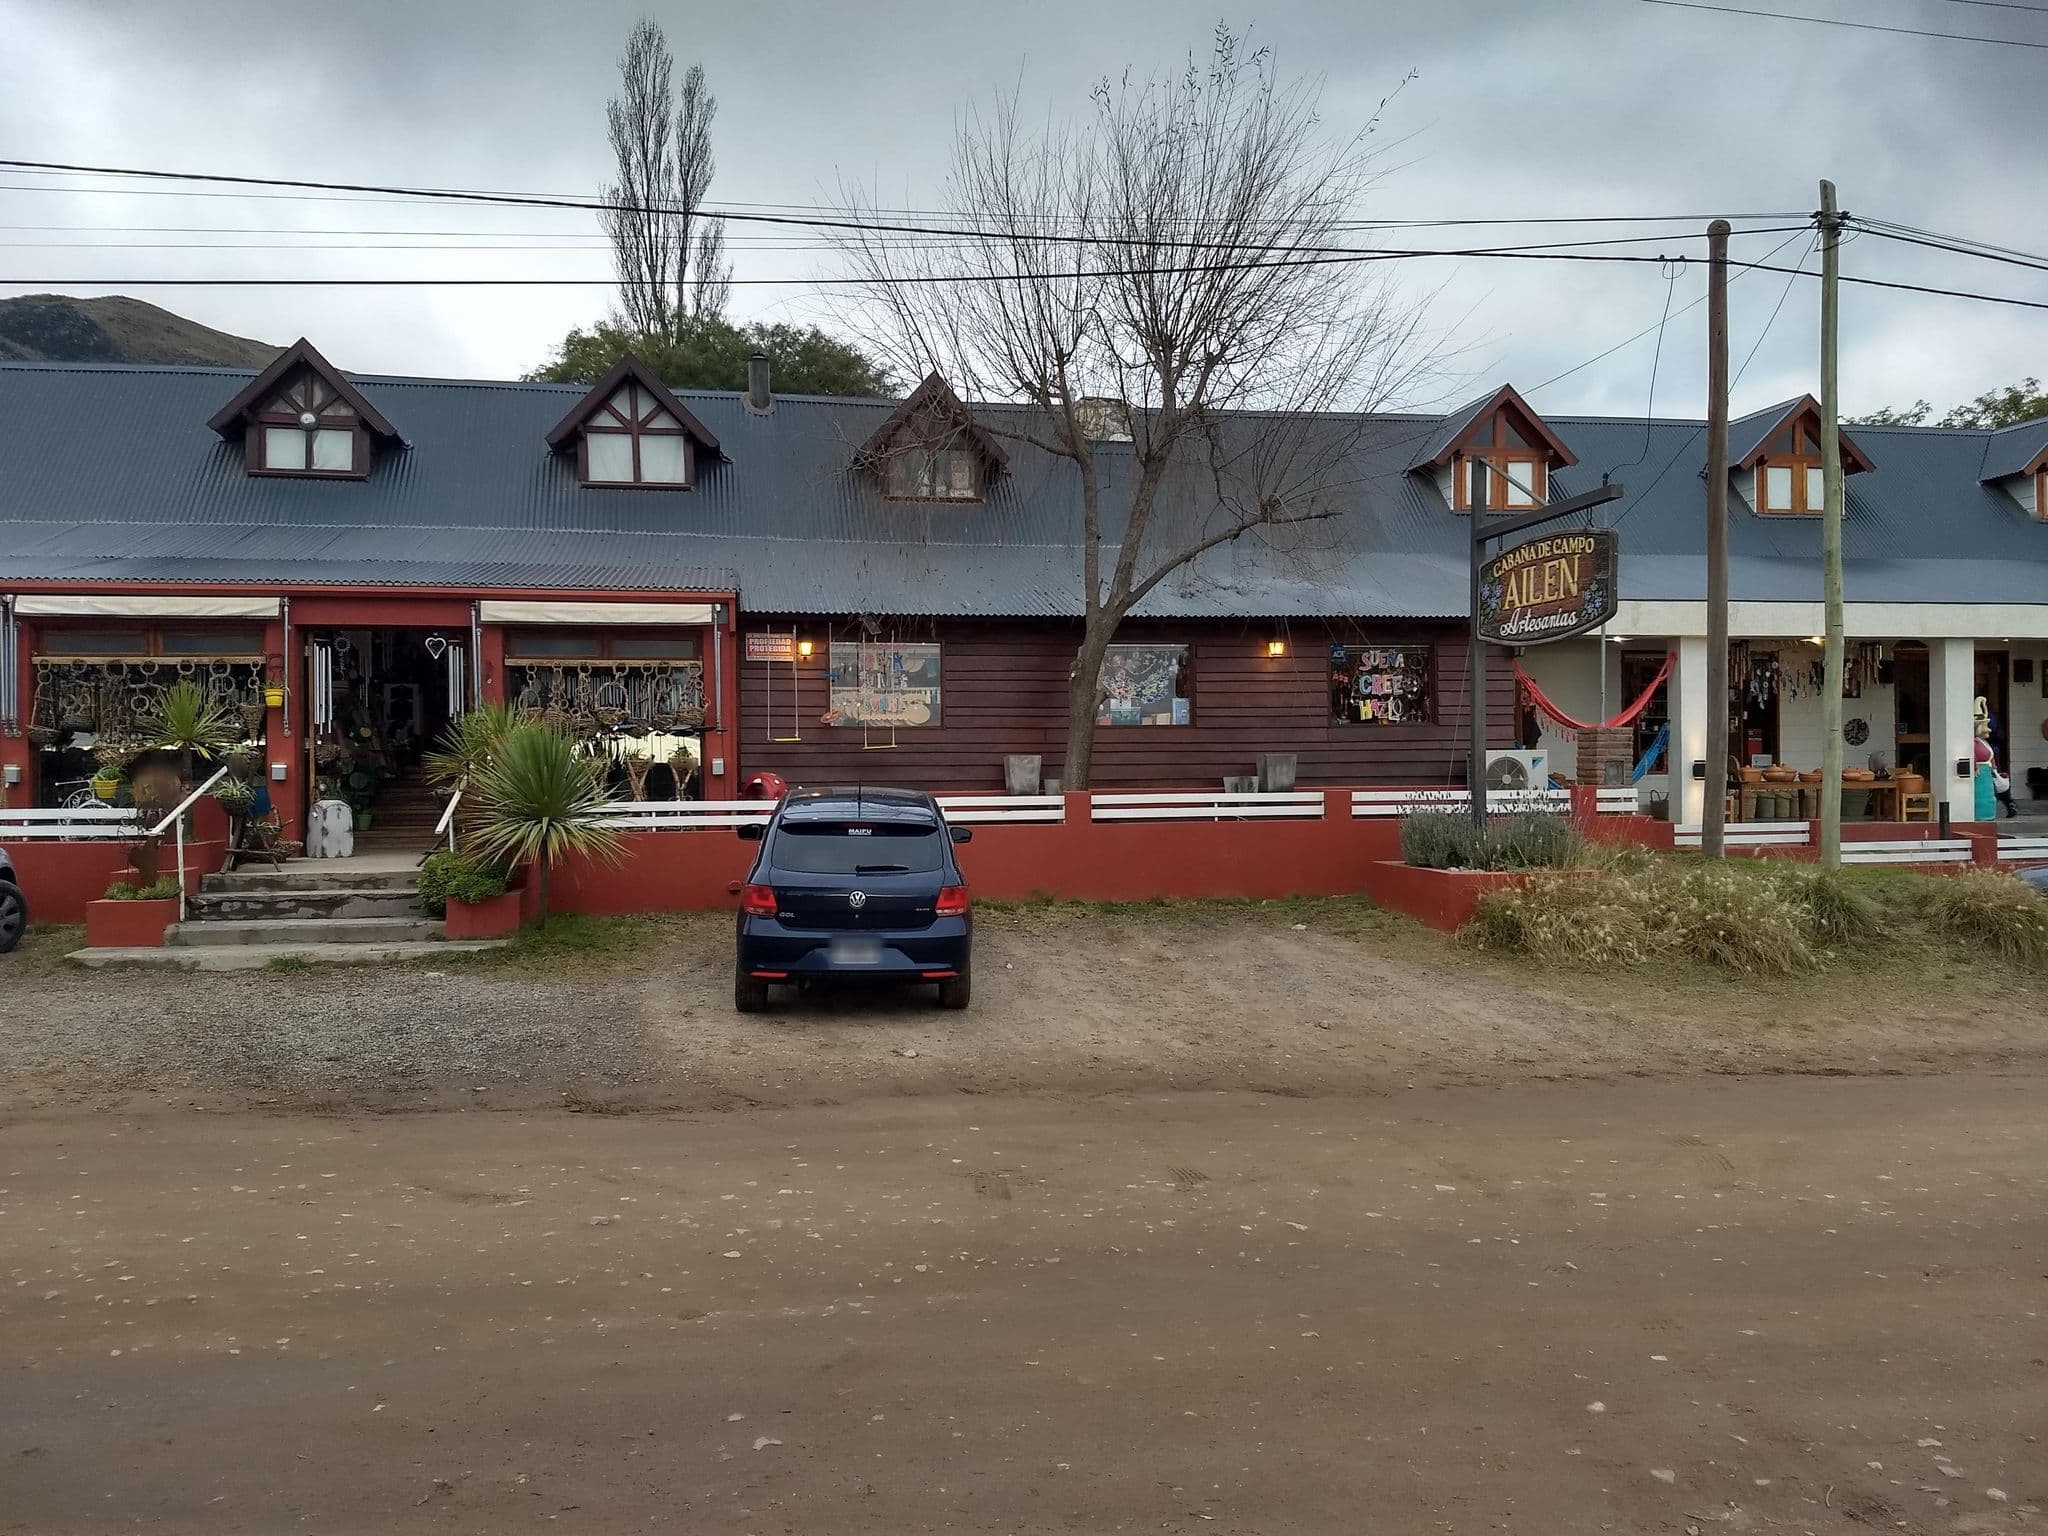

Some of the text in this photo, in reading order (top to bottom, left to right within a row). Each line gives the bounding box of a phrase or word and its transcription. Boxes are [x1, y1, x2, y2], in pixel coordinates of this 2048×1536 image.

[1493, 536, 1595, 578] CABAÑA DE CAMPO
[1502, 554, 1580, 611] AILEN
[1359, 674, 1404, 697] CREE
[1359, 697, 1403, 721] HAZLO
